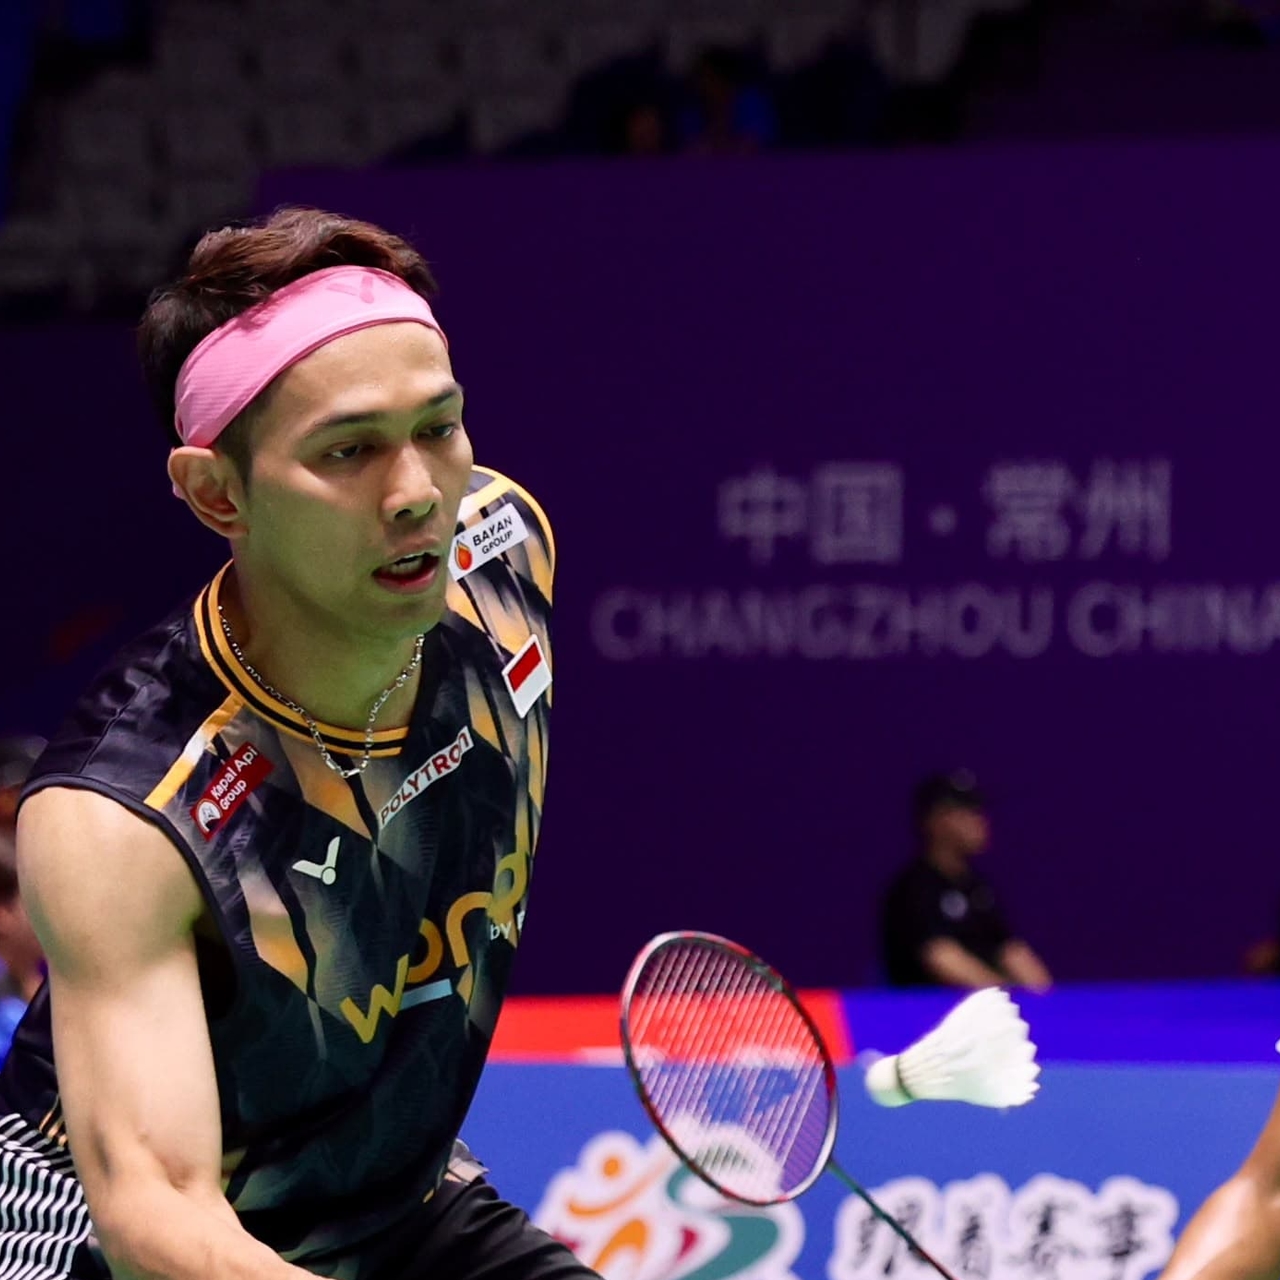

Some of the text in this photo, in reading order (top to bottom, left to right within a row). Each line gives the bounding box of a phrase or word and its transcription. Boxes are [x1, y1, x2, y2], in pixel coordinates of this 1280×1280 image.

[472, 515, 513, 547] BAYAN
[481, 530, 513, 555] GROUP
[590, 582, 1053, 660] CHANGZHOU
[210, 746, 258, 800] Kapal Api
[220, 780, 247, 810] Group
